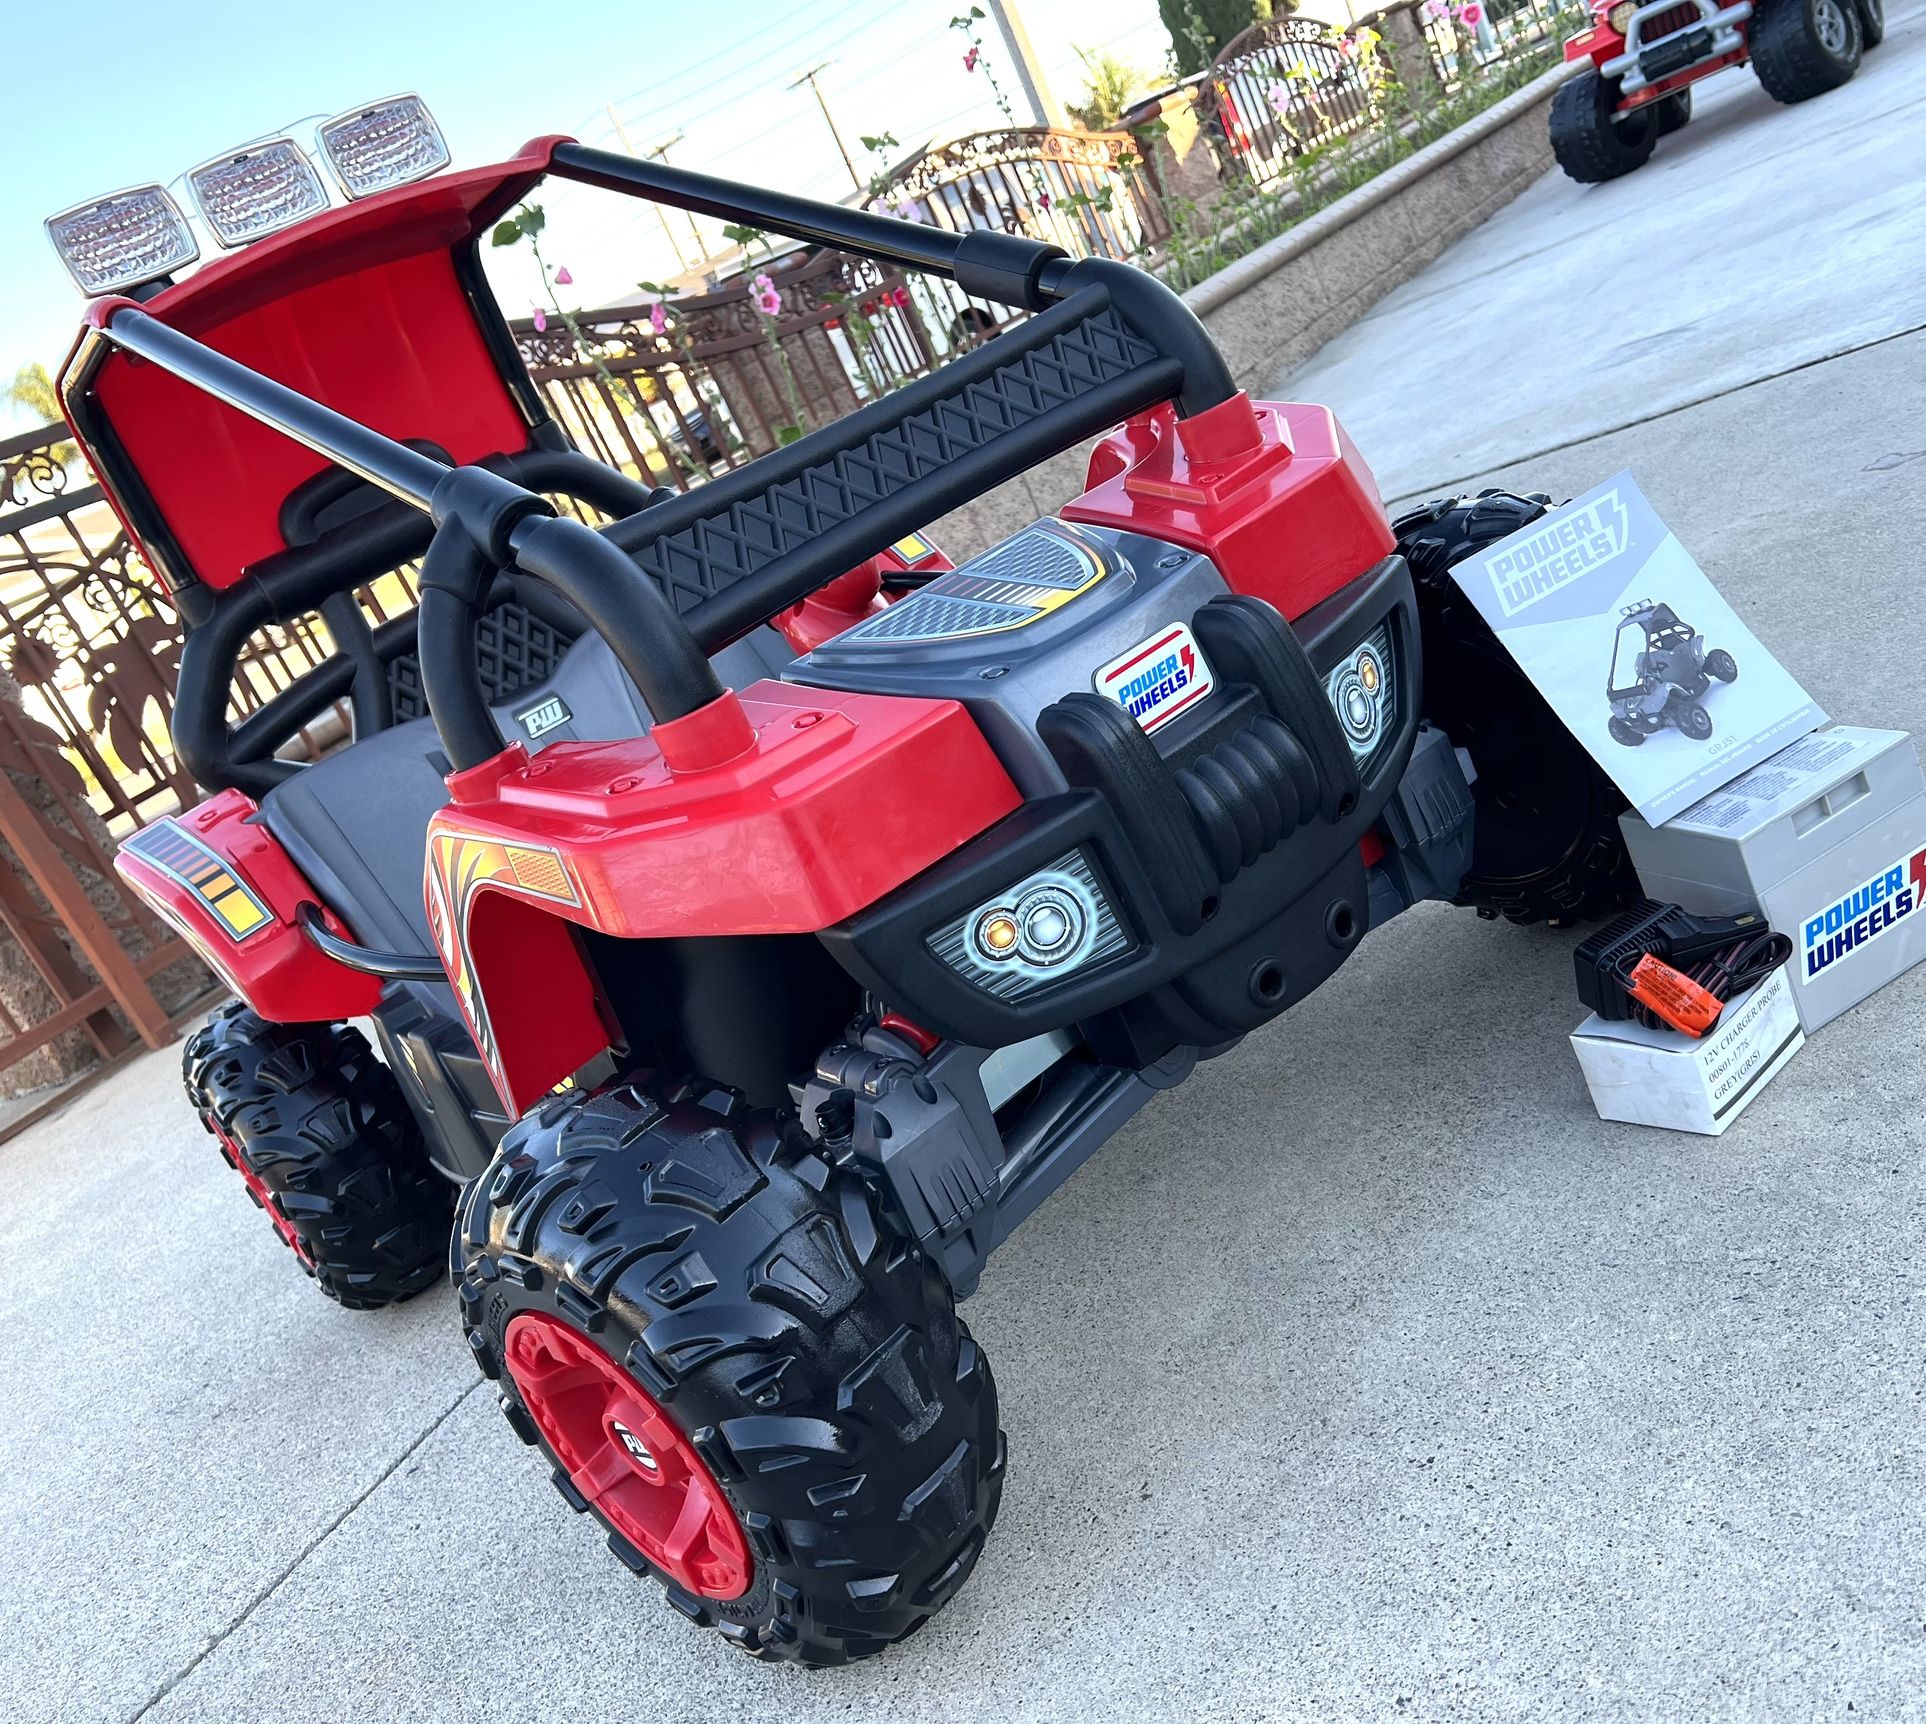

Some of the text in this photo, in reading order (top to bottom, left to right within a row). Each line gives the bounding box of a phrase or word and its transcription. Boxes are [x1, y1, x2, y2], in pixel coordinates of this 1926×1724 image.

[1492, 512, 1595, 584] POWER
[1502, 532, 1613, 609] WHEELS
[1118, 654, 1178, 705] POWER
[525, 701, 563, 735] PW
[1806, 865, 1904, 948] POWER
[1808, 888, 1912, 977] WHEELS
[1704, 1044, 1719, 1066] 12V
